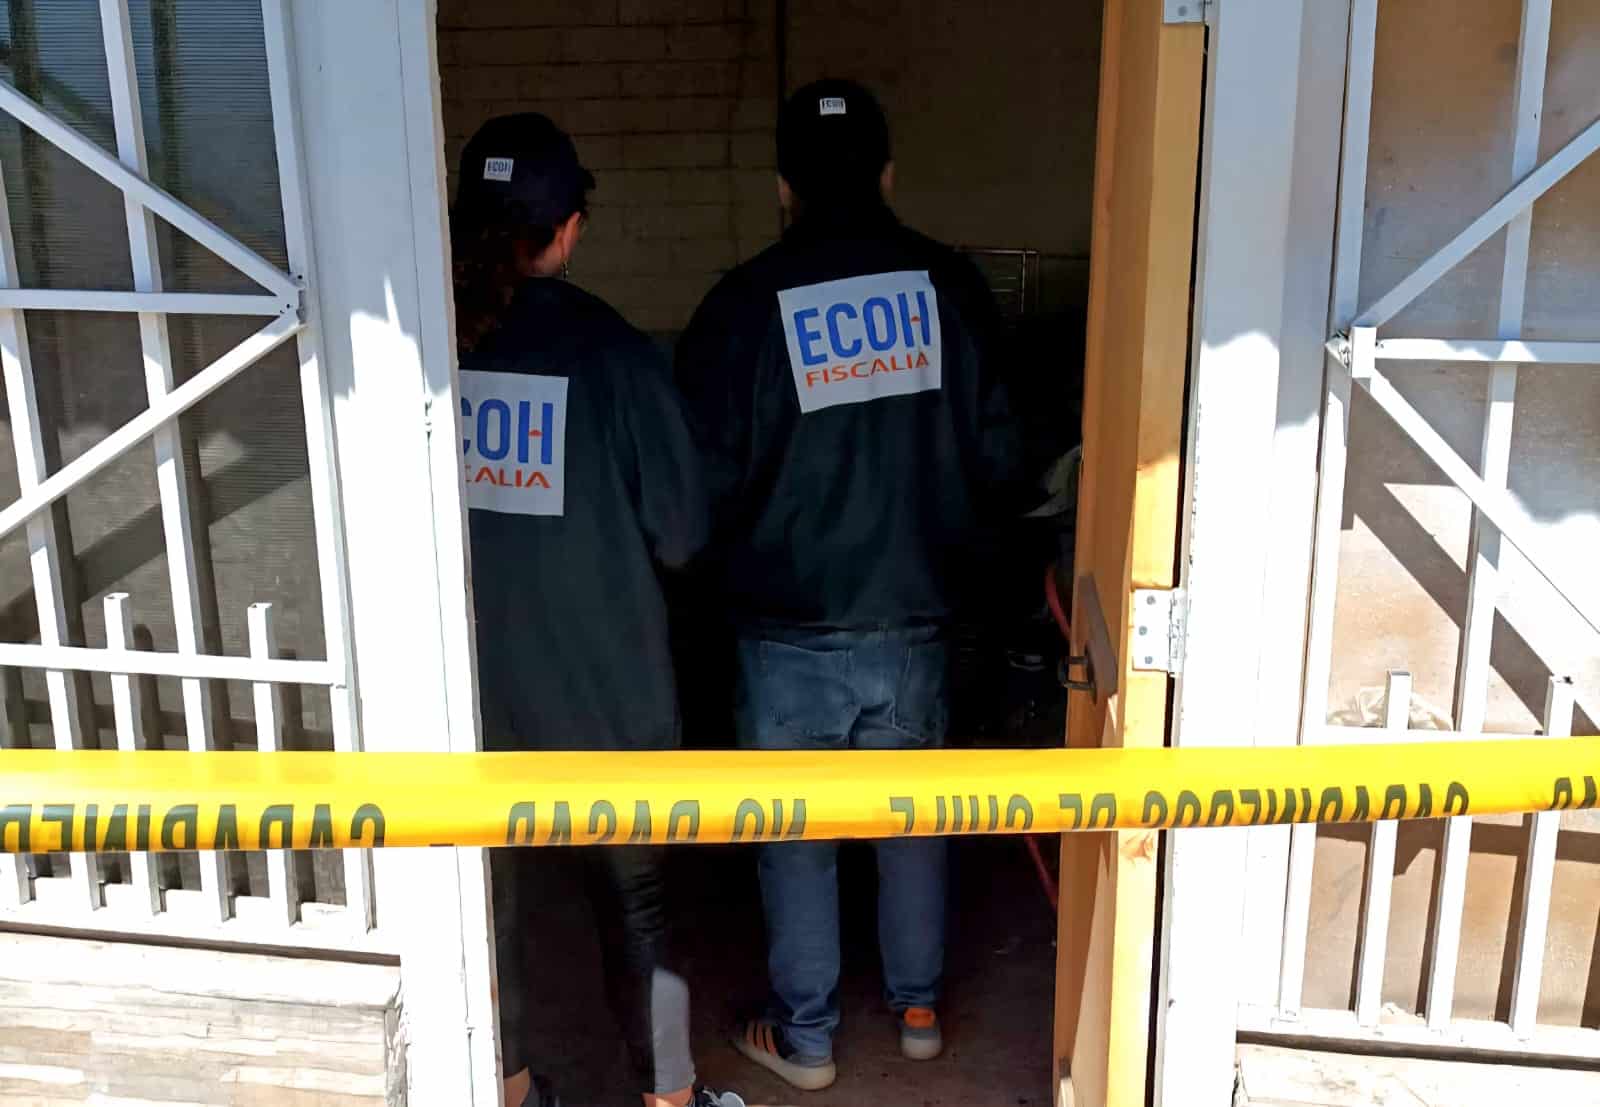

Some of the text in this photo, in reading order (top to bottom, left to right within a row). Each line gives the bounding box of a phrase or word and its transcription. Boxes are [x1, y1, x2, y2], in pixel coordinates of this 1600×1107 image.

[793, 290, 931, 366] ECOH
[805, 351, 929, 388] FISCALIA
[460, 396, 554, 465] OH
[464, 464, 551, 489] ALIA
